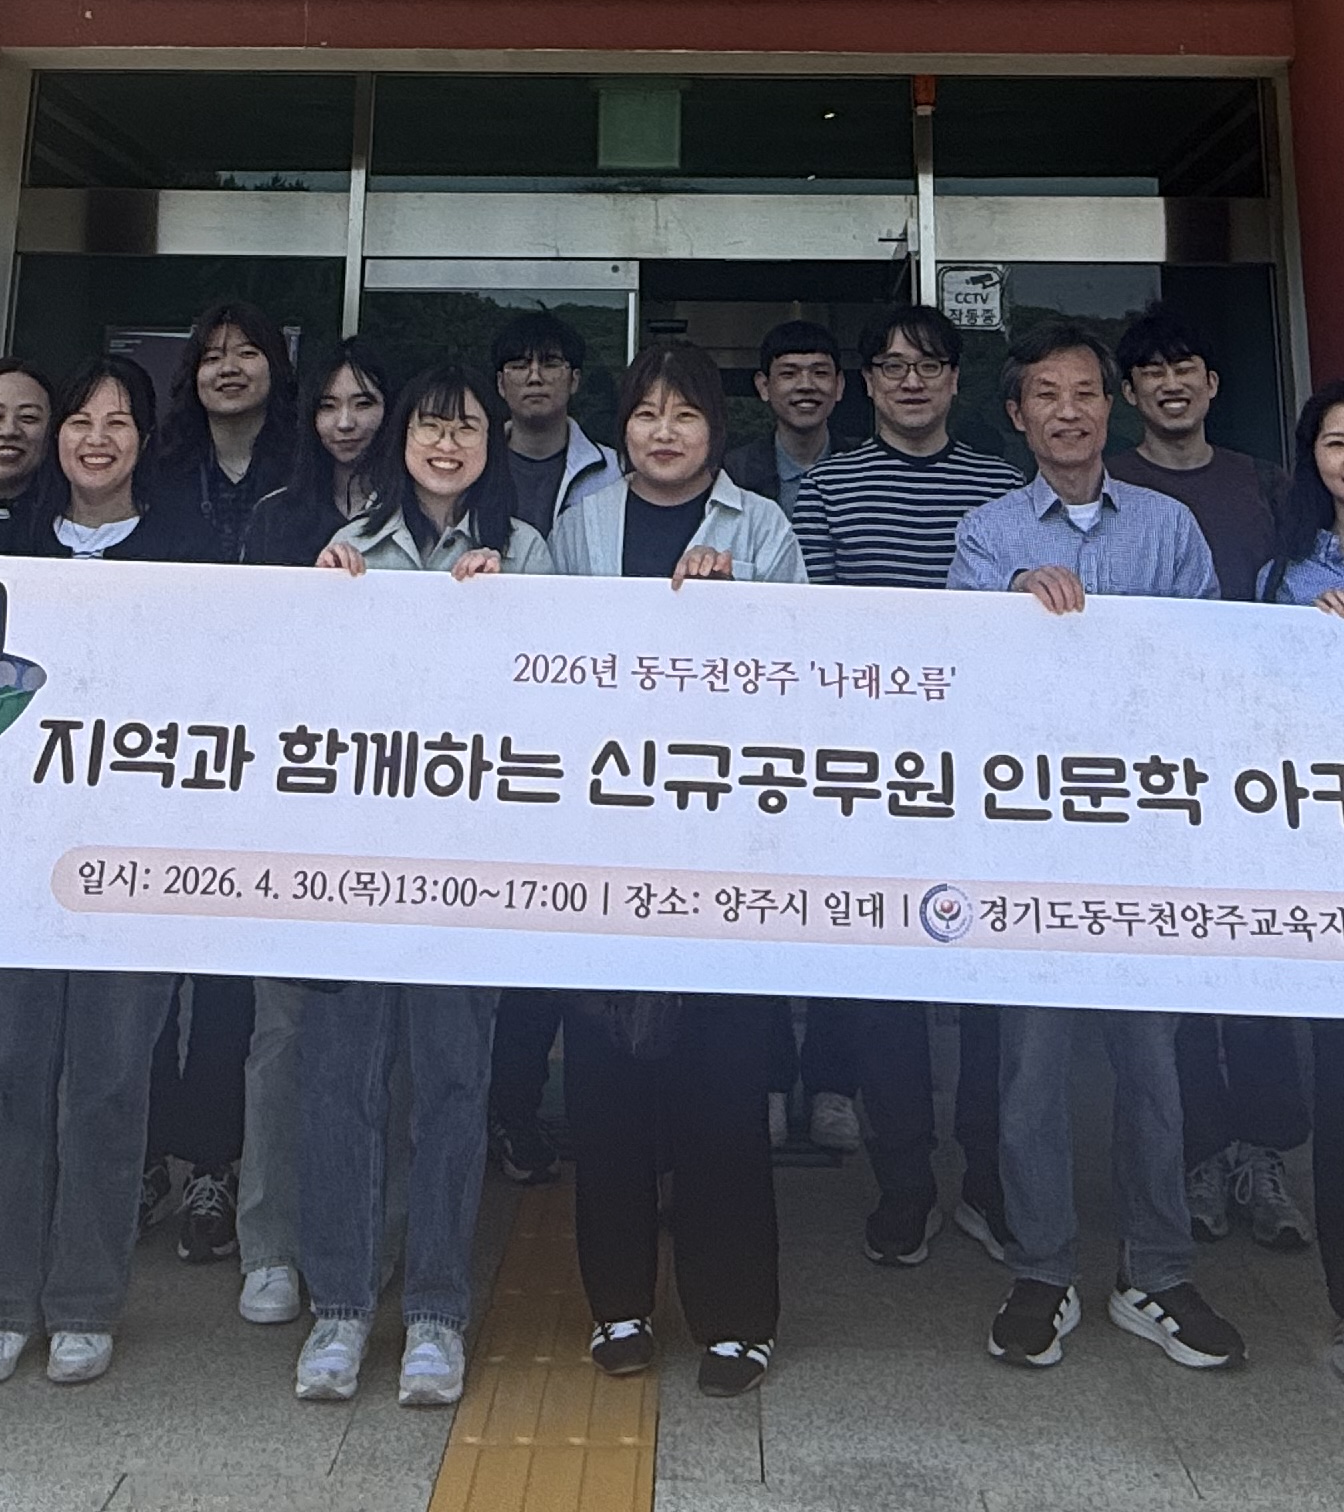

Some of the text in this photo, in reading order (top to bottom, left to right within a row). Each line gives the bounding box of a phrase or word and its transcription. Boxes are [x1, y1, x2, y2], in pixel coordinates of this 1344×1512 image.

[949, 308, 995, 325] 작동중
[955, 292, 989, 305] CCTV
[512, 652, 956, 702] 2026년 동두천양주 '나래오름'
[32, 718, 256, 792] 지역과
[276, 724, 565, 804] 함께하는
[589, 740, 956, 819] 신규공무원
[983, 754, 1210, 826] 인문학
[78, 860, 151, 898] 일시:
[163, 865, 242, 898] 2026.
[254, 868, 279, 900] 4.
[624, 882, 700, 919] 장소:
[714, 885, 808, 927] 양주시
[824, 890, 884, 930] 일대
